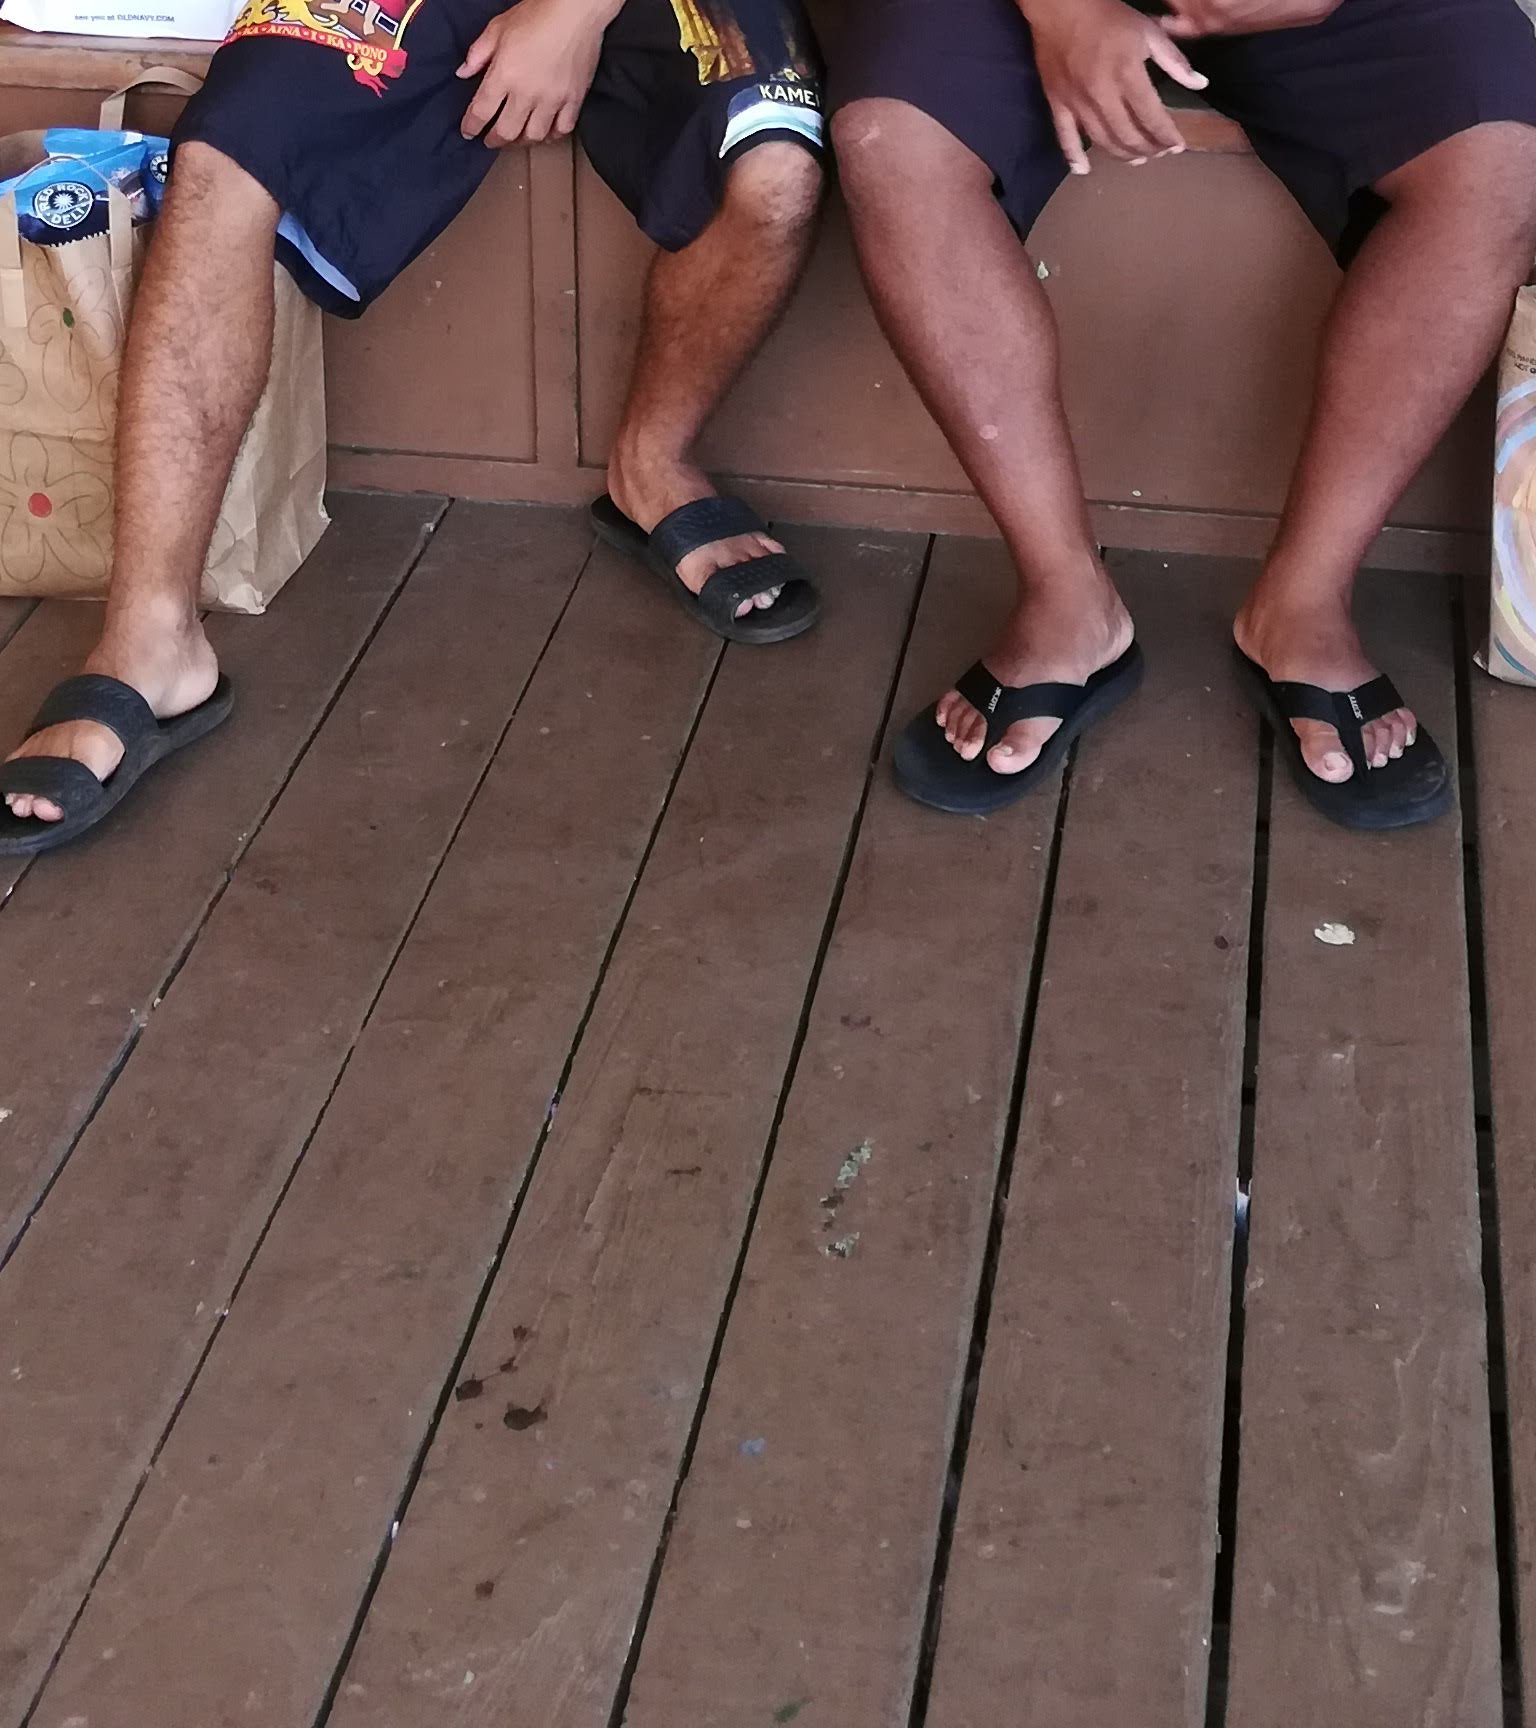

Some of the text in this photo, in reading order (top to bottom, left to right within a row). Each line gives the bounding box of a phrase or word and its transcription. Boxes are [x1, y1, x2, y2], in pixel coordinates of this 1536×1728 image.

[116, 14, 176, 23] OLDNAVY.COM
[326, 34, 346, 50] KA
[353, 41, 388, 62] PONO
[39, 183, 93, 213] RED ROCK
[49, 200, 88, 225] DELI
[1346, 693, 1364, 720] SCOTT
